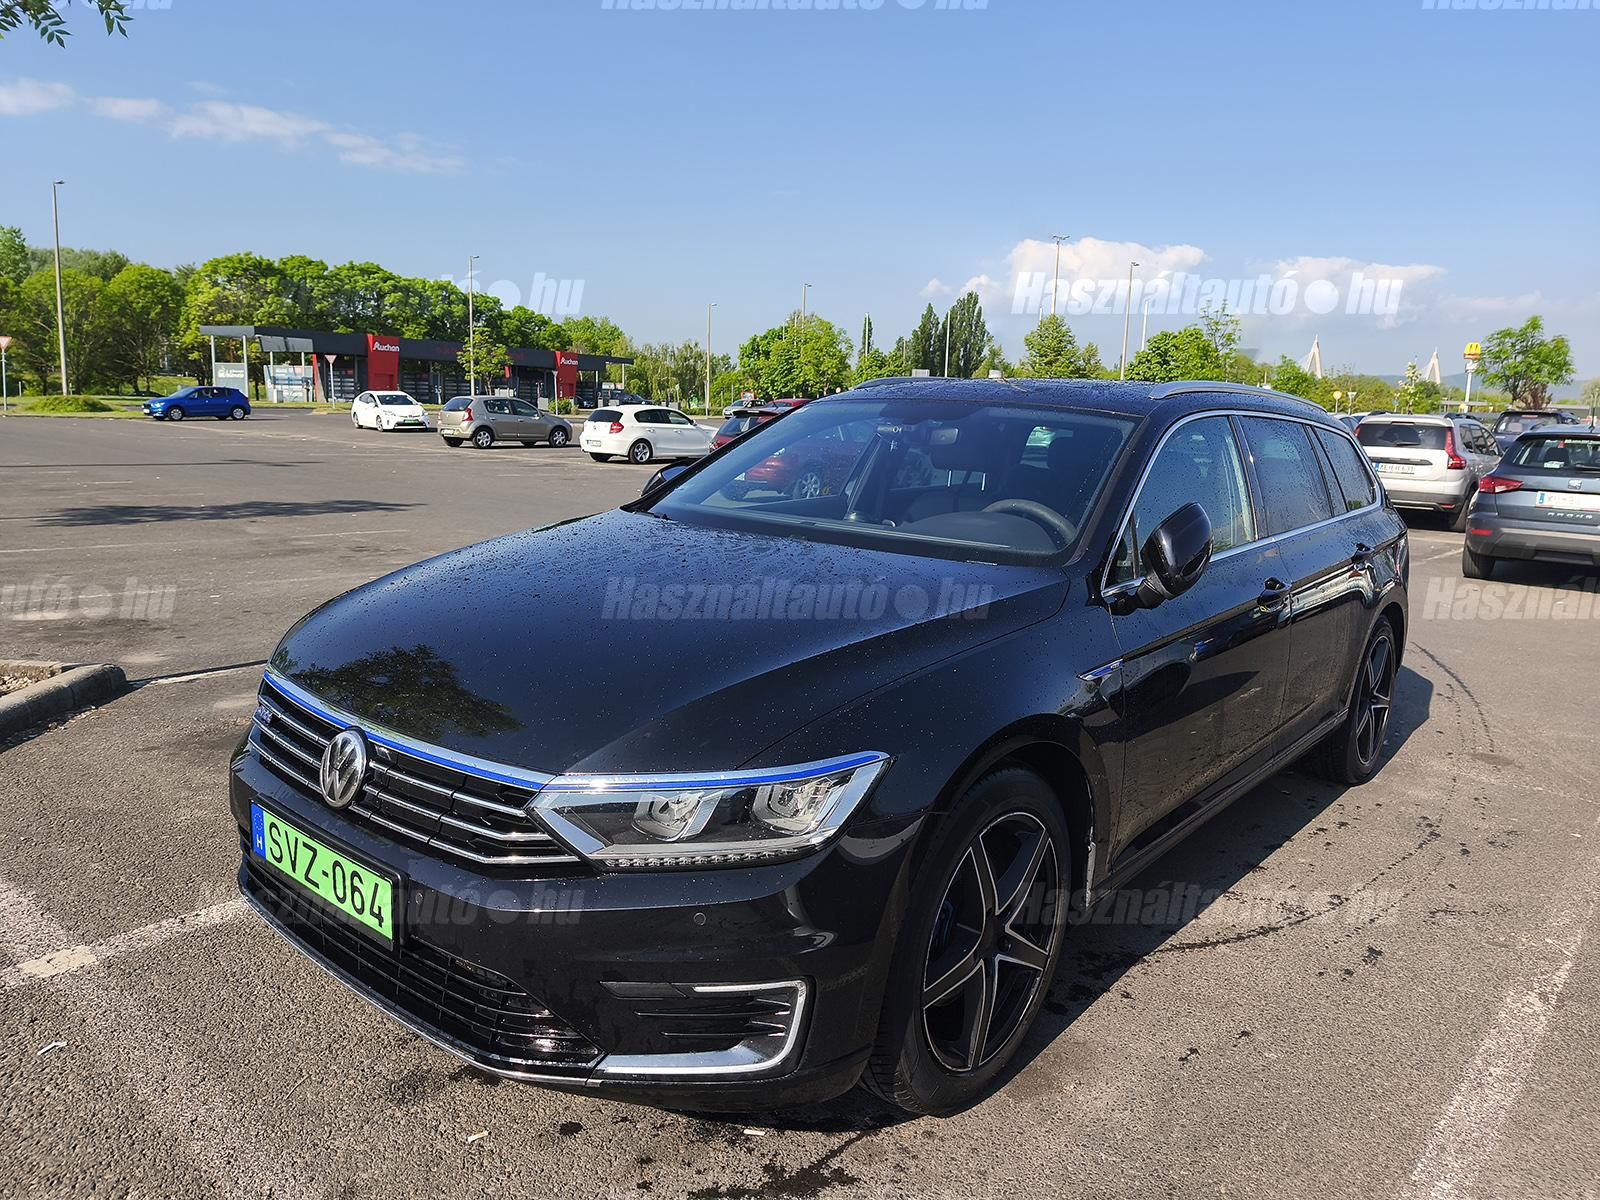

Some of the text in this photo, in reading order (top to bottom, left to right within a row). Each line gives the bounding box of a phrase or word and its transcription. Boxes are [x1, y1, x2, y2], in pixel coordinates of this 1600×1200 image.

[373, 341, 400, 352] Auchan
[560, 356, 579, 366] Auchan
[256, 820, 385, 930] H SVZ-064
